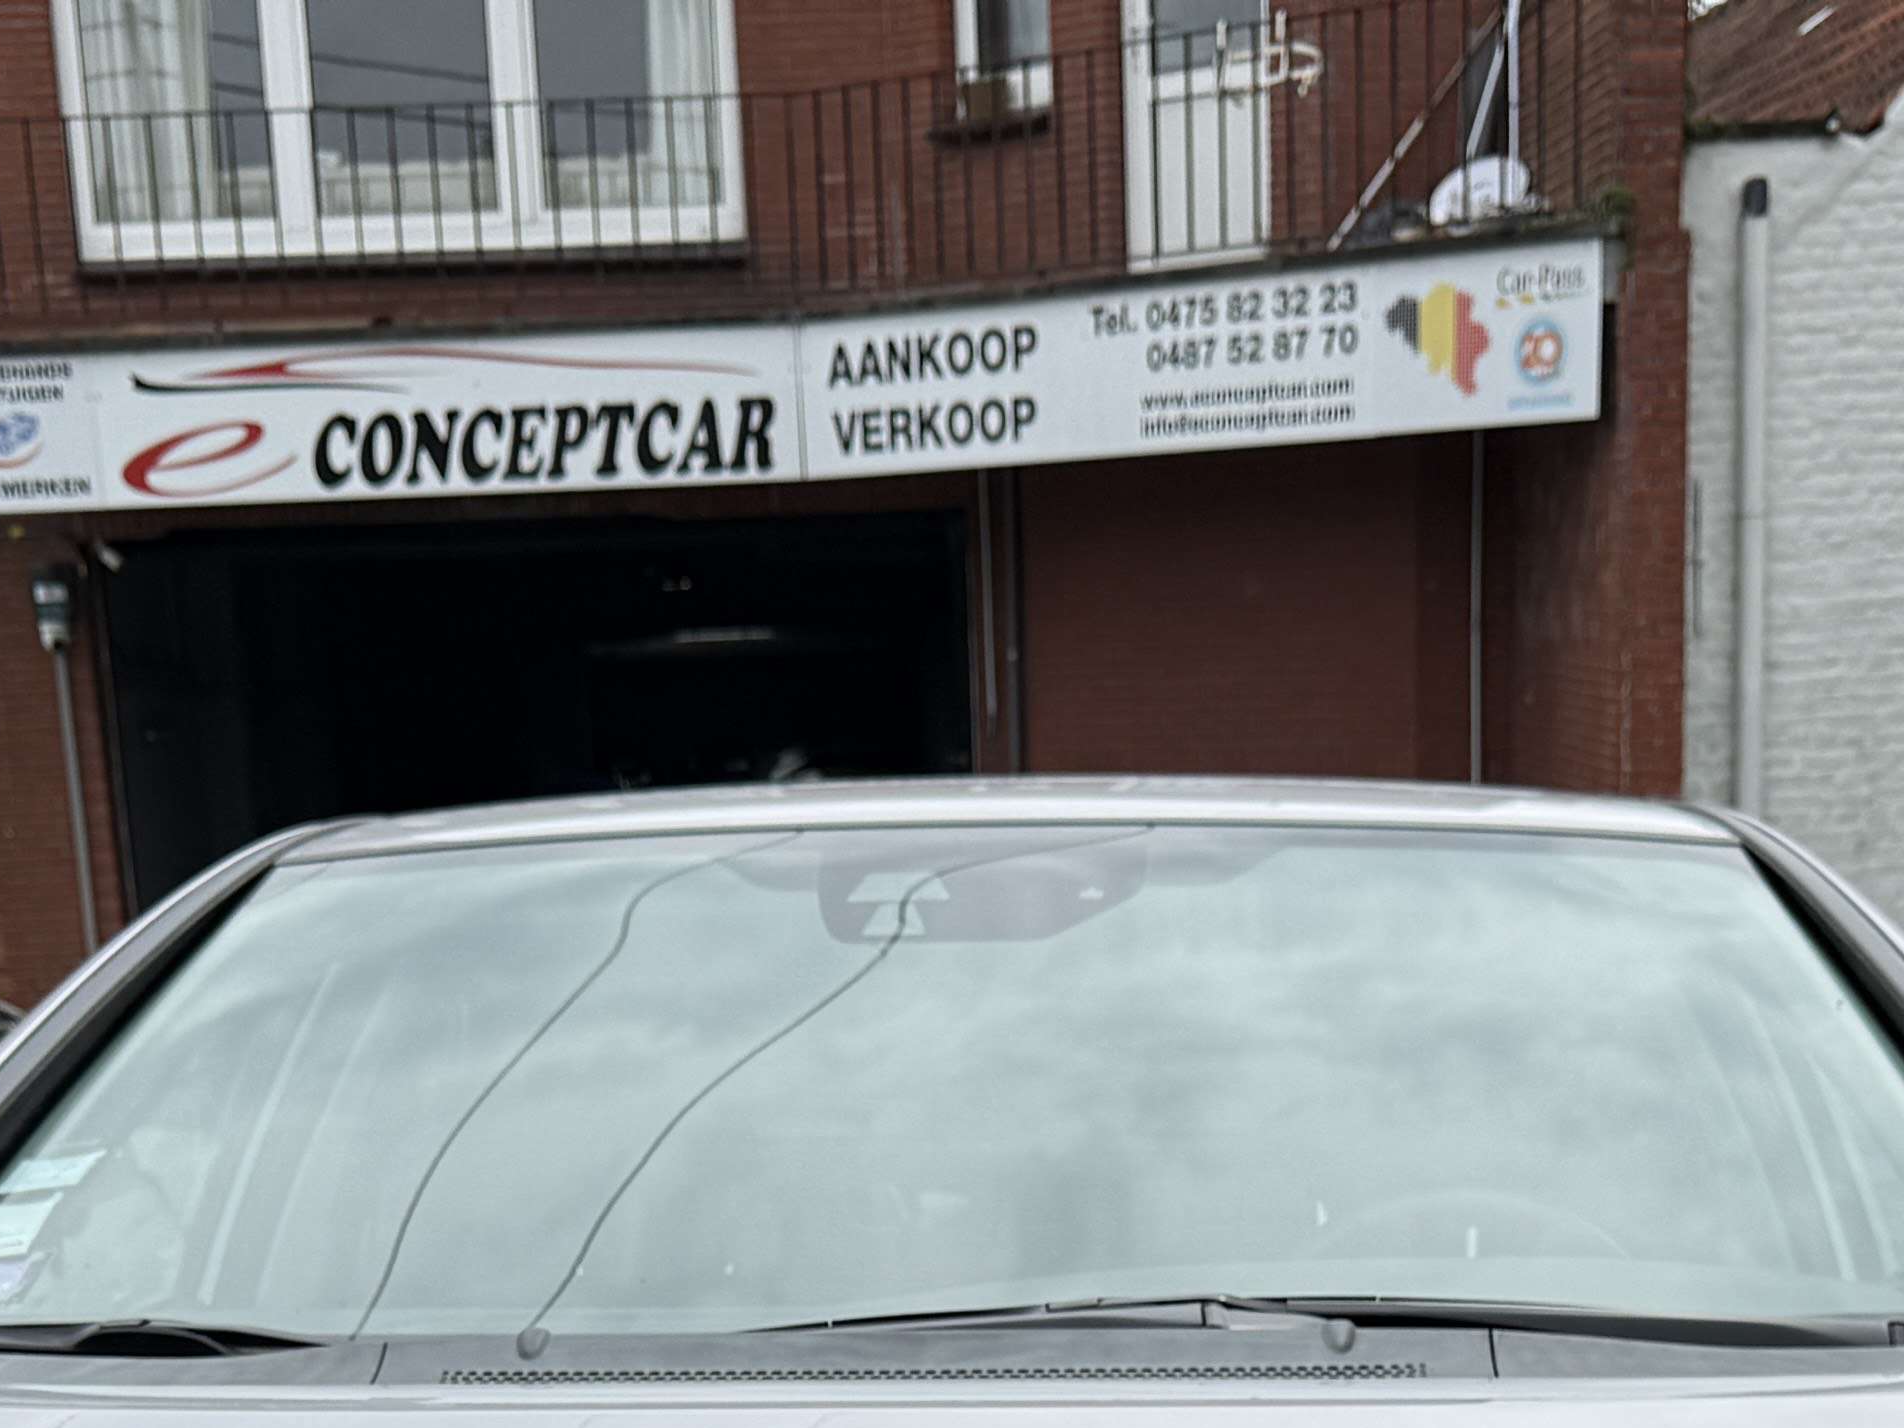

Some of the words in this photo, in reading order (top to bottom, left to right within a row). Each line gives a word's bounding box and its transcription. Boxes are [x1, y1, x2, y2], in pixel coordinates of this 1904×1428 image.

[1090, 302, 1138, 335] Tel.
[1146, 294, 1218, 331] 0475
[1226, 289, 1264, 323] 82
[1272, 285, 1311, 318] 32
[1319, 280, 1358, 313] 23
[827, 324, 1037, 389] AANKOOP
[1146, 335, 1217, 372] 0487
[1226, 331, 1264, 365] 52
[1272, 326, 1311, 361] 87
[1319, 321, 1359, 357] 70
[312, 398, 776, 488] CONCEPTCAR
[832, 396, 1037, 456] VERKOOP
